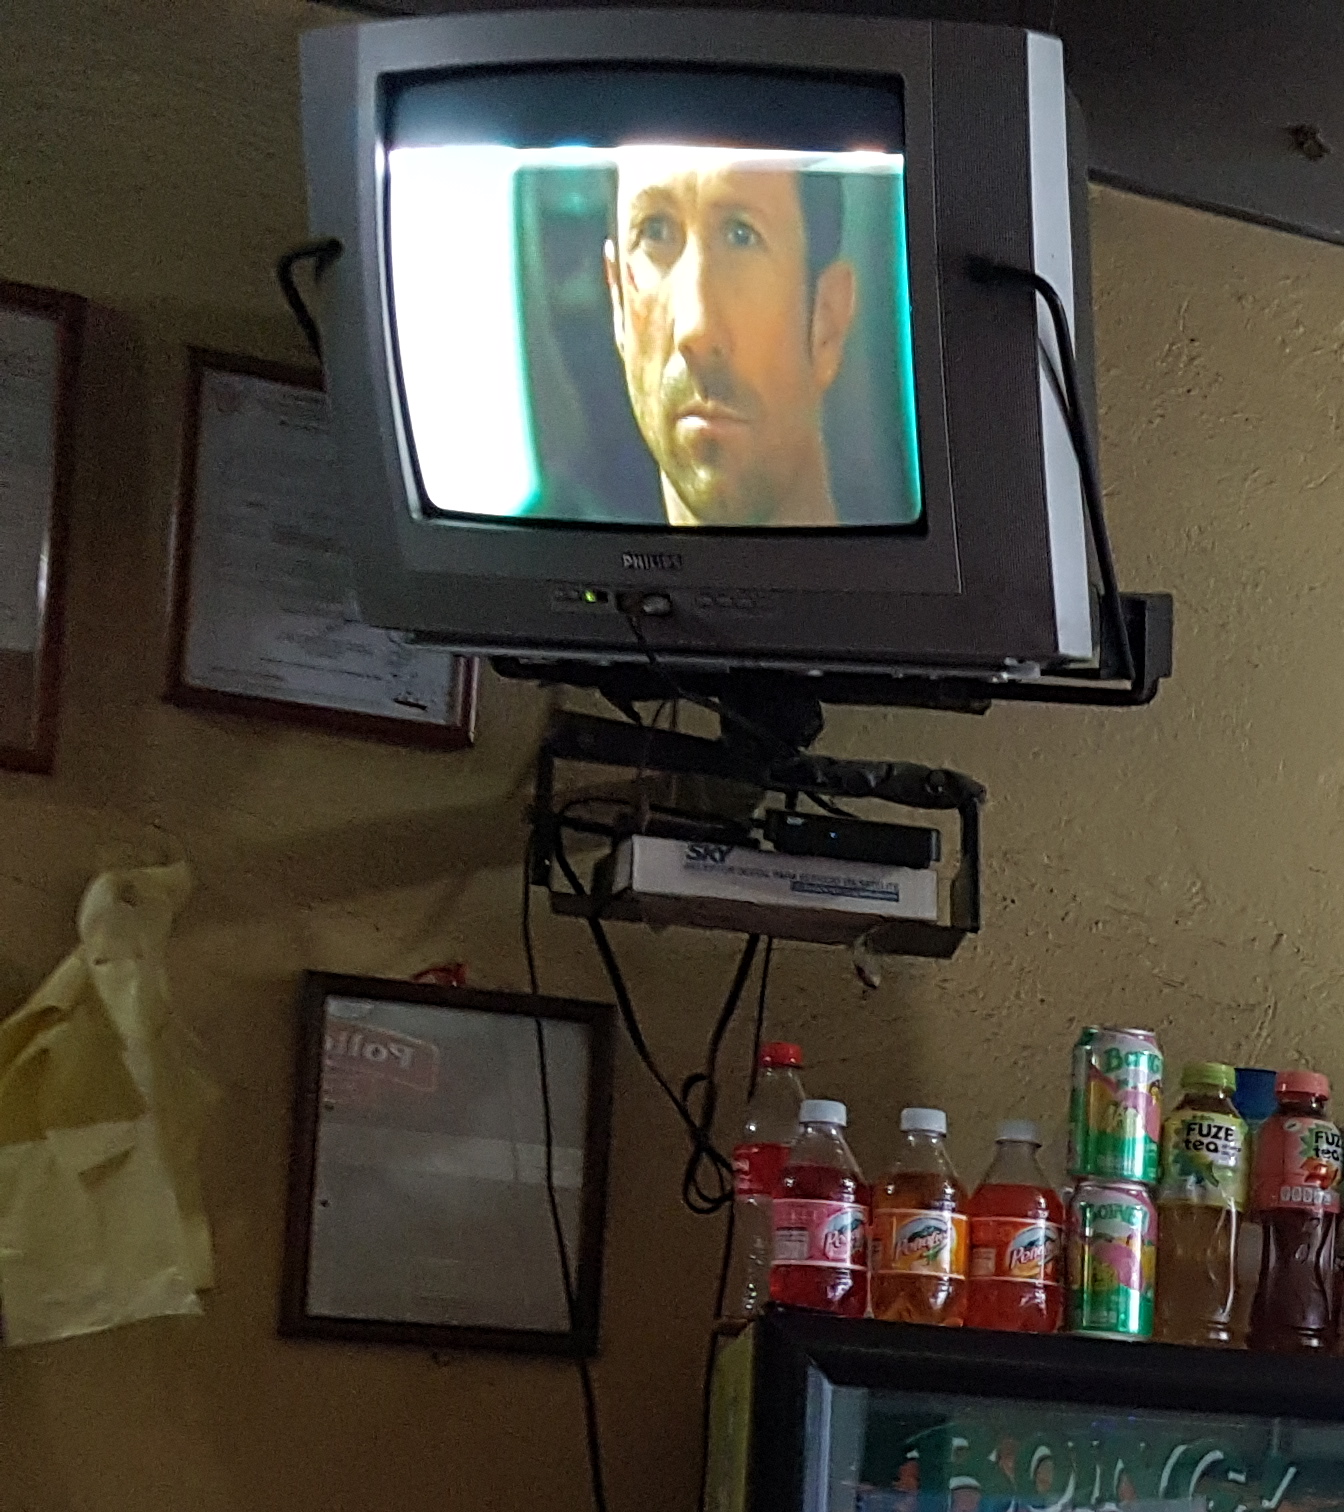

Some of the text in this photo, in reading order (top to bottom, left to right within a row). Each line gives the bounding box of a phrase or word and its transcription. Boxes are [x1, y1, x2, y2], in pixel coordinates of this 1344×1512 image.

[685, 844, 734, 866] SKY
[1184, 1121, 1235, 1142] FUZE
[1313, 1130, 1342, 1146] FUZ
[1183, 1136, 1219, 1153] tea
